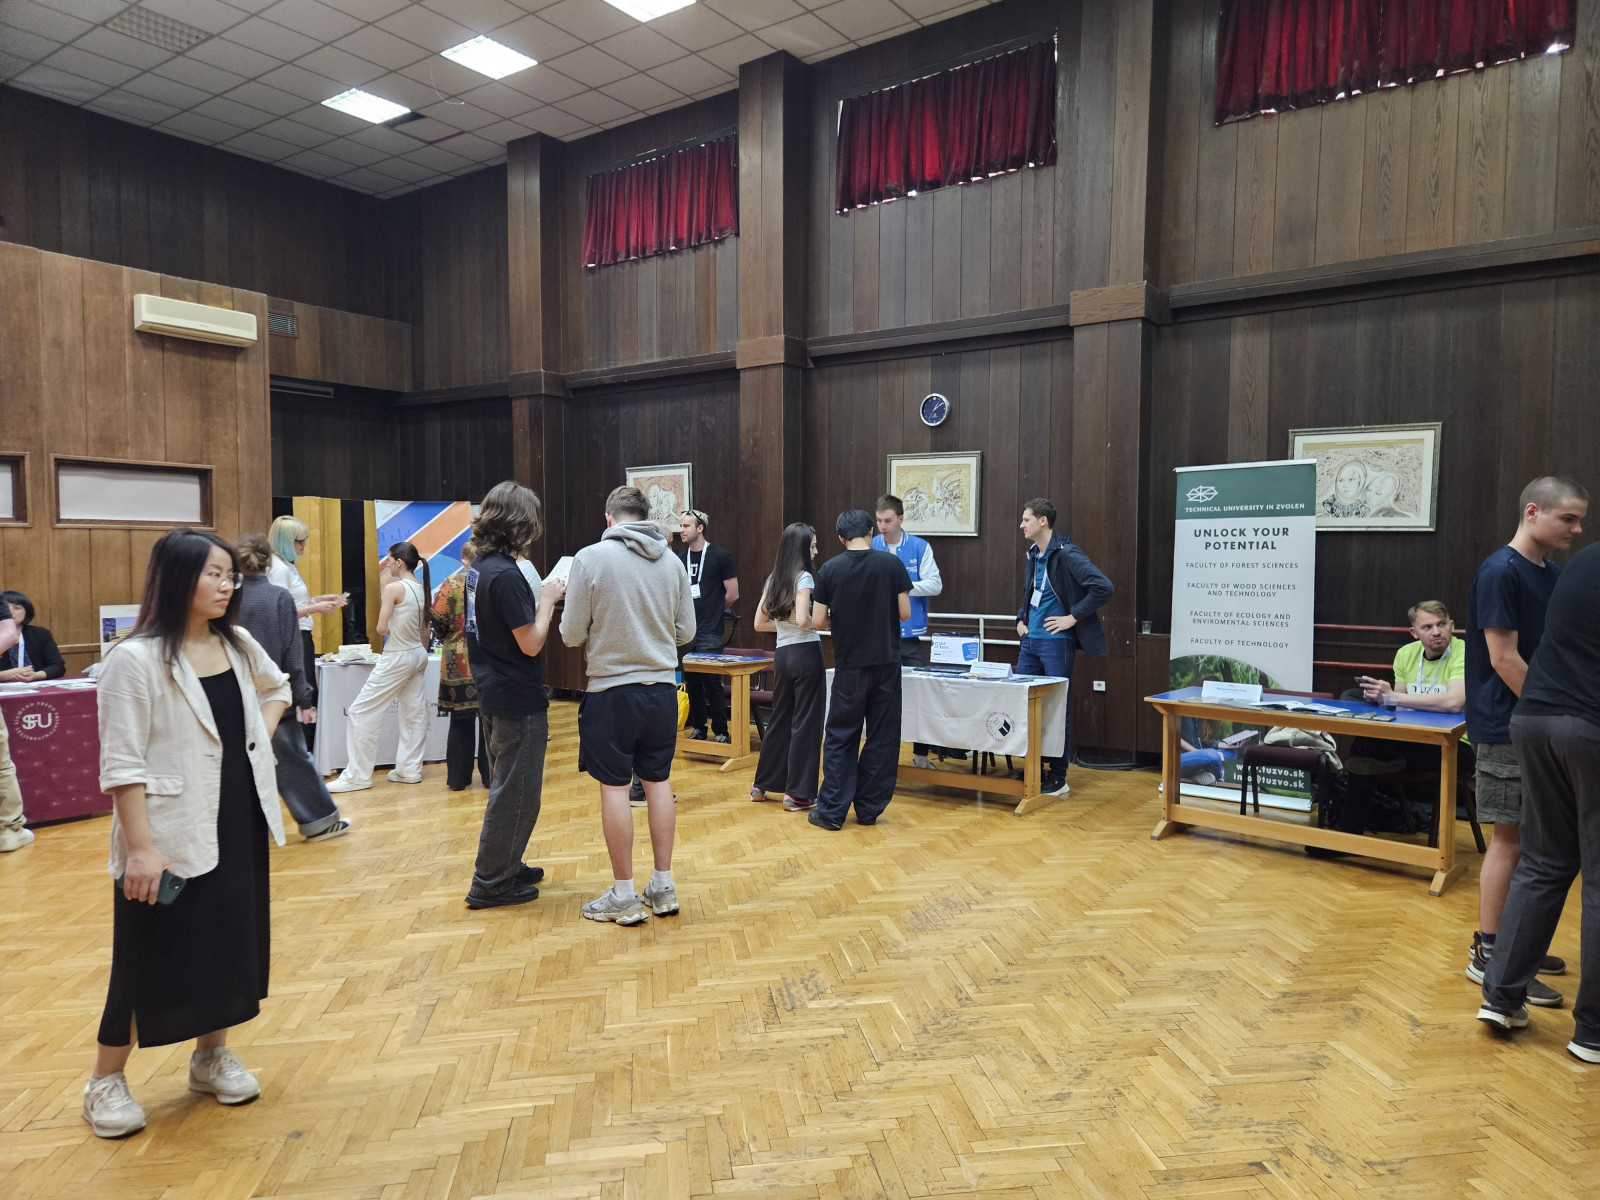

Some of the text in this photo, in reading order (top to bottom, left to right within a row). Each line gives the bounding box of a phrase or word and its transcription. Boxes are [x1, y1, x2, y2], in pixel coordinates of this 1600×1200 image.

[1223, 504, 1264, 512] UNIVERSITY
[1193, 527, 1290, 538] UNLOCK YOUR
[1204, 541, 1277, 550] POTENTIAL
[1192, 618, 1289, 628] ENVIROMENTAL SCIENCES
[1190, 637, 1222, 645] FACULTY
[1237, 640, 1289, 649] TECHNOLOGY
